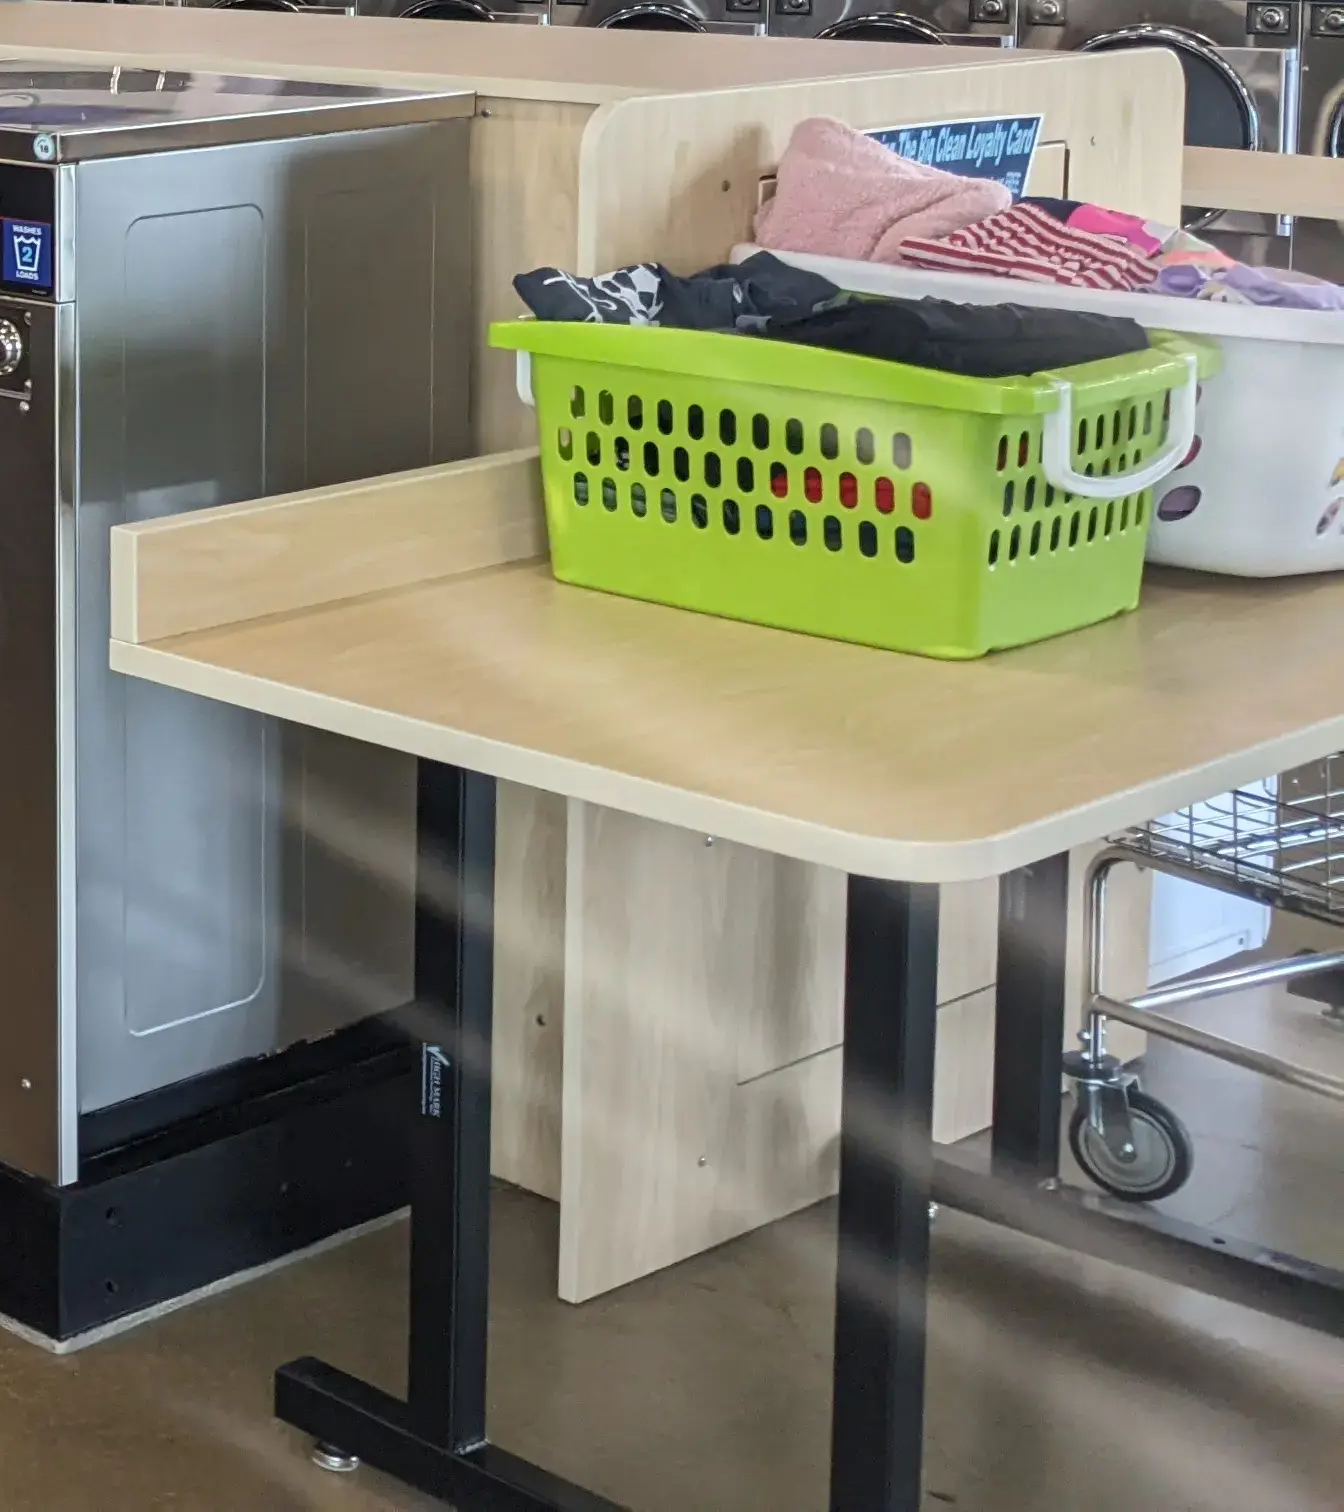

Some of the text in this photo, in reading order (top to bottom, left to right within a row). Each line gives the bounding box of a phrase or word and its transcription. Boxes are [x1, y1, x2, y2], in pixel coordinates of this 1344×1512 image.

[936, 126, 967, 163] Clean
[965, 122, 1007, 168] Loyalty
[1006, 120, 1037, 155] Card
[12, 224, 42, 236] WASHES
[21, 246, 33, 263] 2
[15, 269, 39, 281] LOADS
